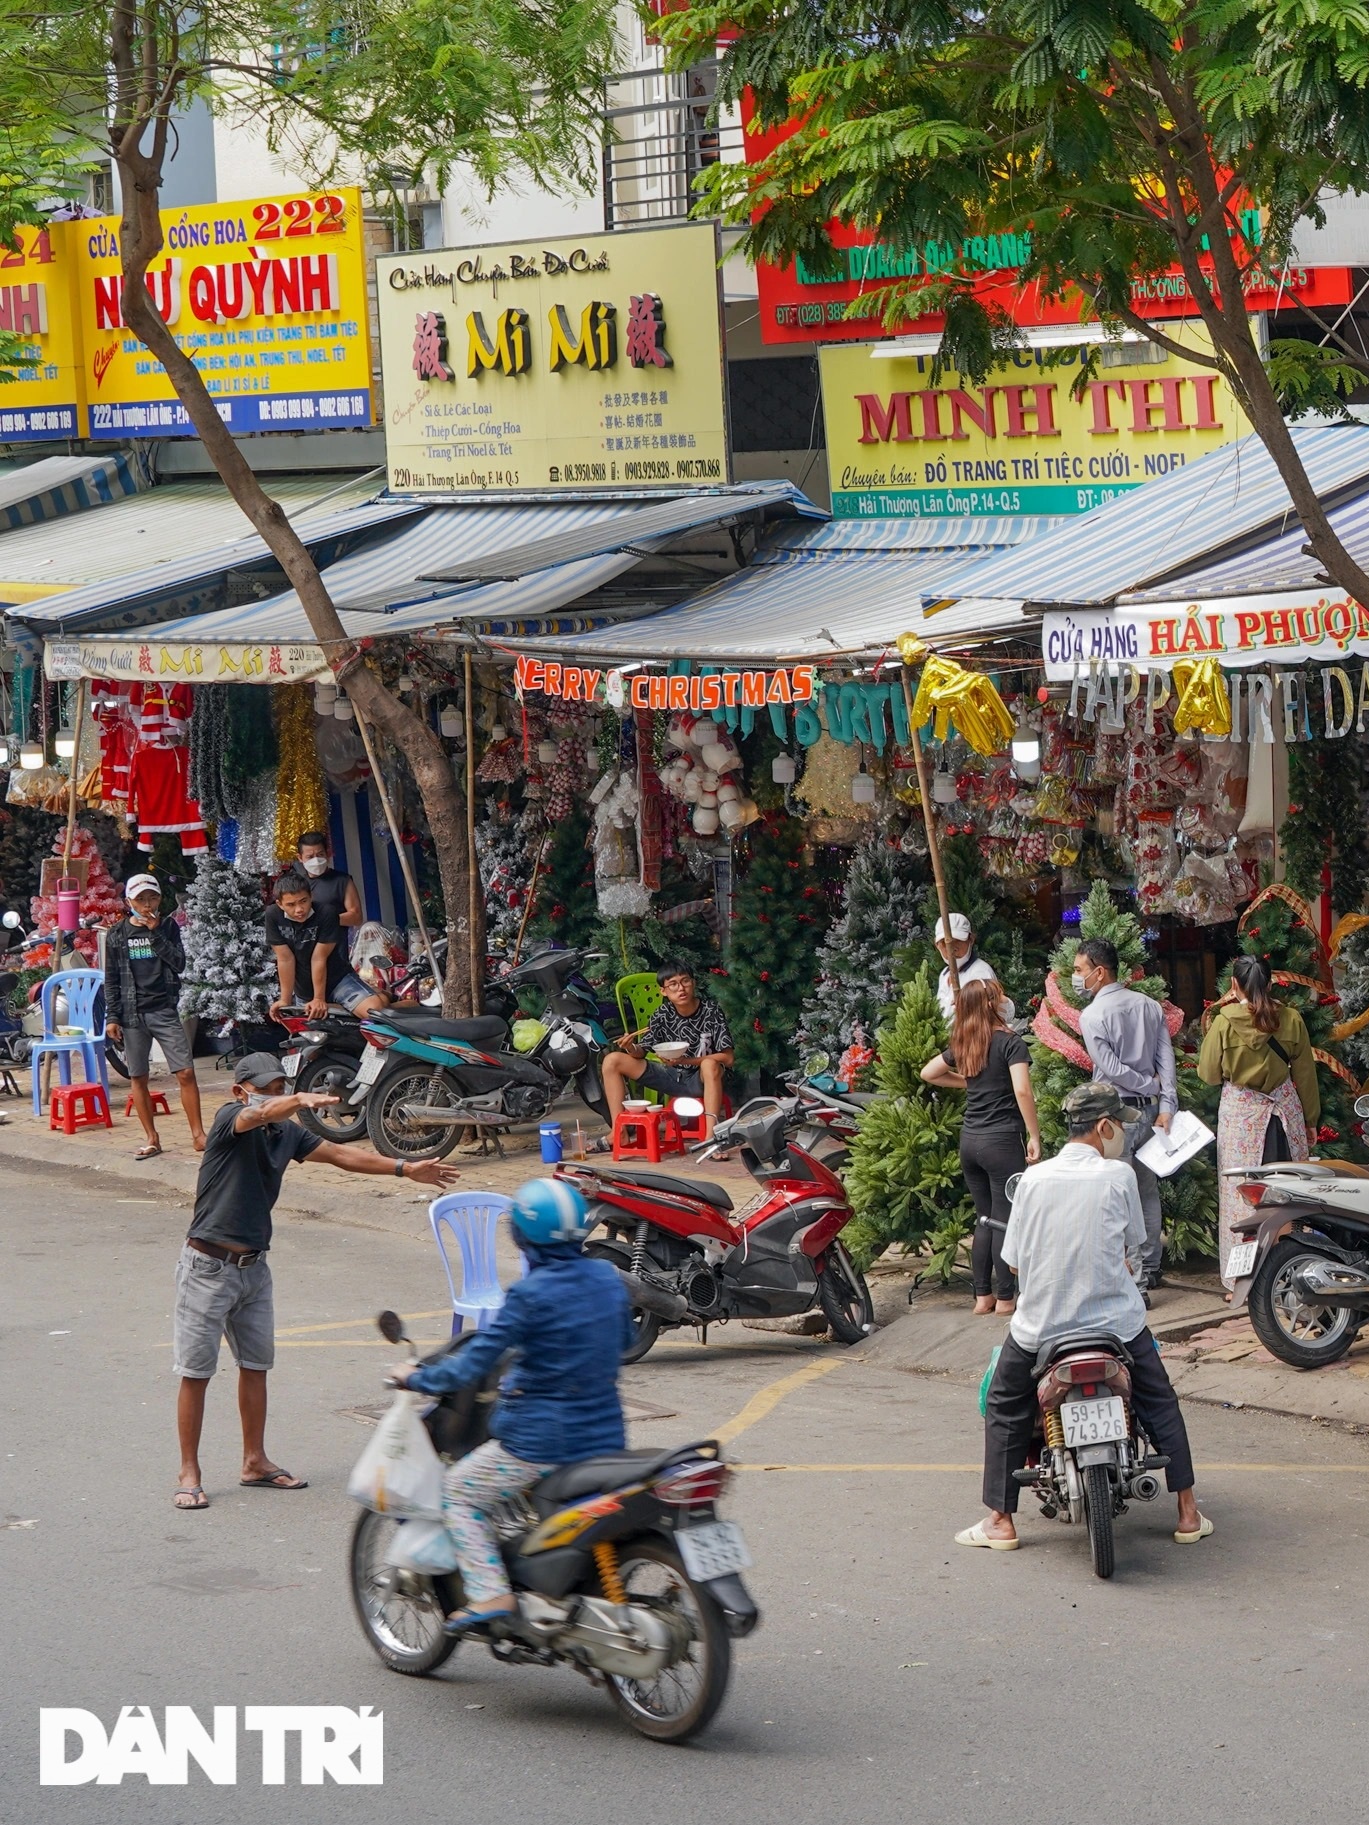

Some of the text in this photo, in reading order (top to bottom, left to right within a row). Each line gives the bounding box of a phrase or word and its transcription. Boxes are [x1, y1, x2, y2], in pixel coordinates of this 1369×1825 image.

[88, 196, 345, 260] CỬA CỔNG HOA 222
[94, 246, 331, 330] NƯ QUỲNH
[797, 304, 825, 326] (028)
[466, 300, 617, 379] Mi Mi
[93, 404, 112, 428] 222
[854, 376, 1223, 444] MINH THI
[503, 422, 521, 434] Hoa
[426, 445, 451, 462] Trang
[467, 444, 487, 457] Noel
[394, 468, 411, 488] 220
[925, 453, 947, 483] ĐỒ
[952, 459, 1005, 482] TRANG
[1011, 452, 1039, 479] TRÍ
[1046, 452, 1084, 484] TIỆC
[1089, 450, 1130, 478] CƯỚI
[859, 493, 878, 514] Hải
[881, 491, 920, 515] Thượng
[923, 492, 944, 512] Lãn
[1048, 616, 1083, 663] CỬA
[1091, 616, 1138, 659] HÀNG
[1149, 604, 1228, 656] HẢI
[159, 646, 264, 675] Mi Mi
[289, 648, 304, 661] 220
[630, 663, 815, 710] CHRISTMAS
[1071, 1401, 1112, 1423] 59-F1
[1068, 1420, 1122, 1444] 743.26
